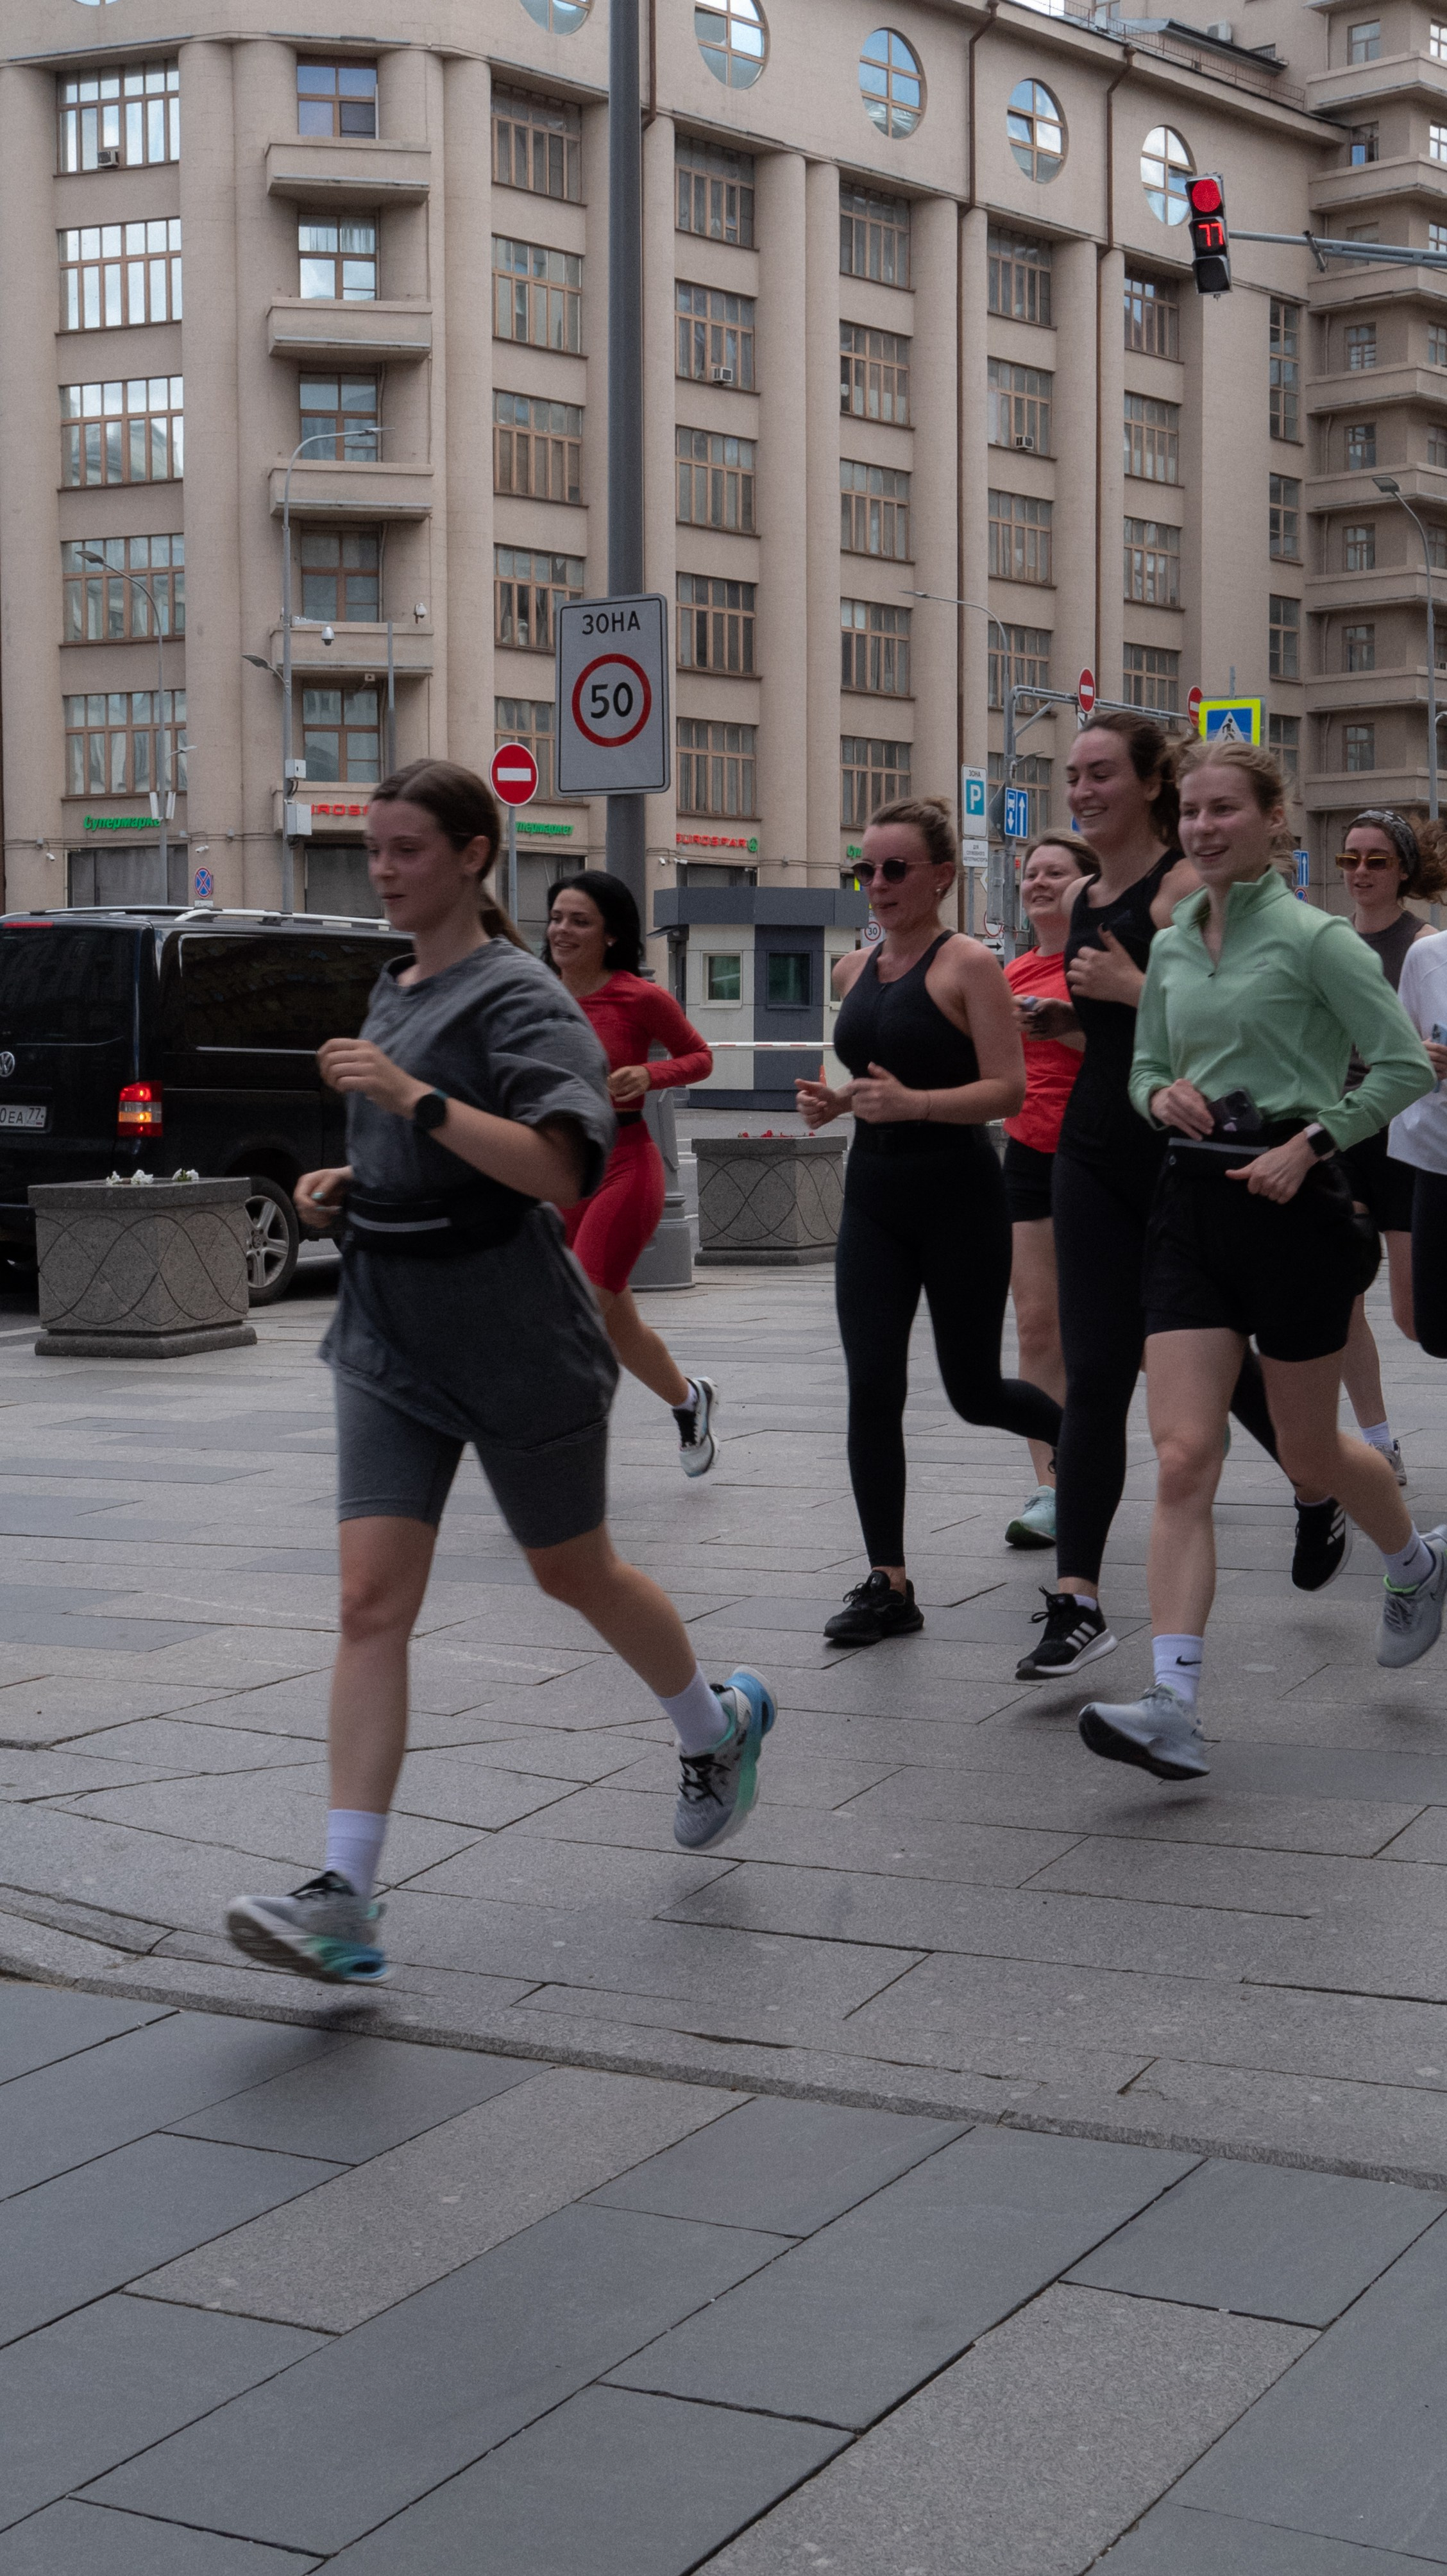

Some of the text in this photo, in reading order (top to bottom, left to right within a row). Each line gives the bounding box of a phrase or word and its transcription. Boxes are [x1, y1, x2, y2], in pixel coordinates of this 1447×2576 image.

[1198, 223, 1224, 247] 77
[582, 611, 641, 635] ЗОНА
[590, 682, 634, 719] 50
[969, 770, 981, 778] ЗОНА
[83, 815, 161, 831] Супермарке
[868, 927, 877, 935] 30
[29, 1107, 41, 1120] 77
